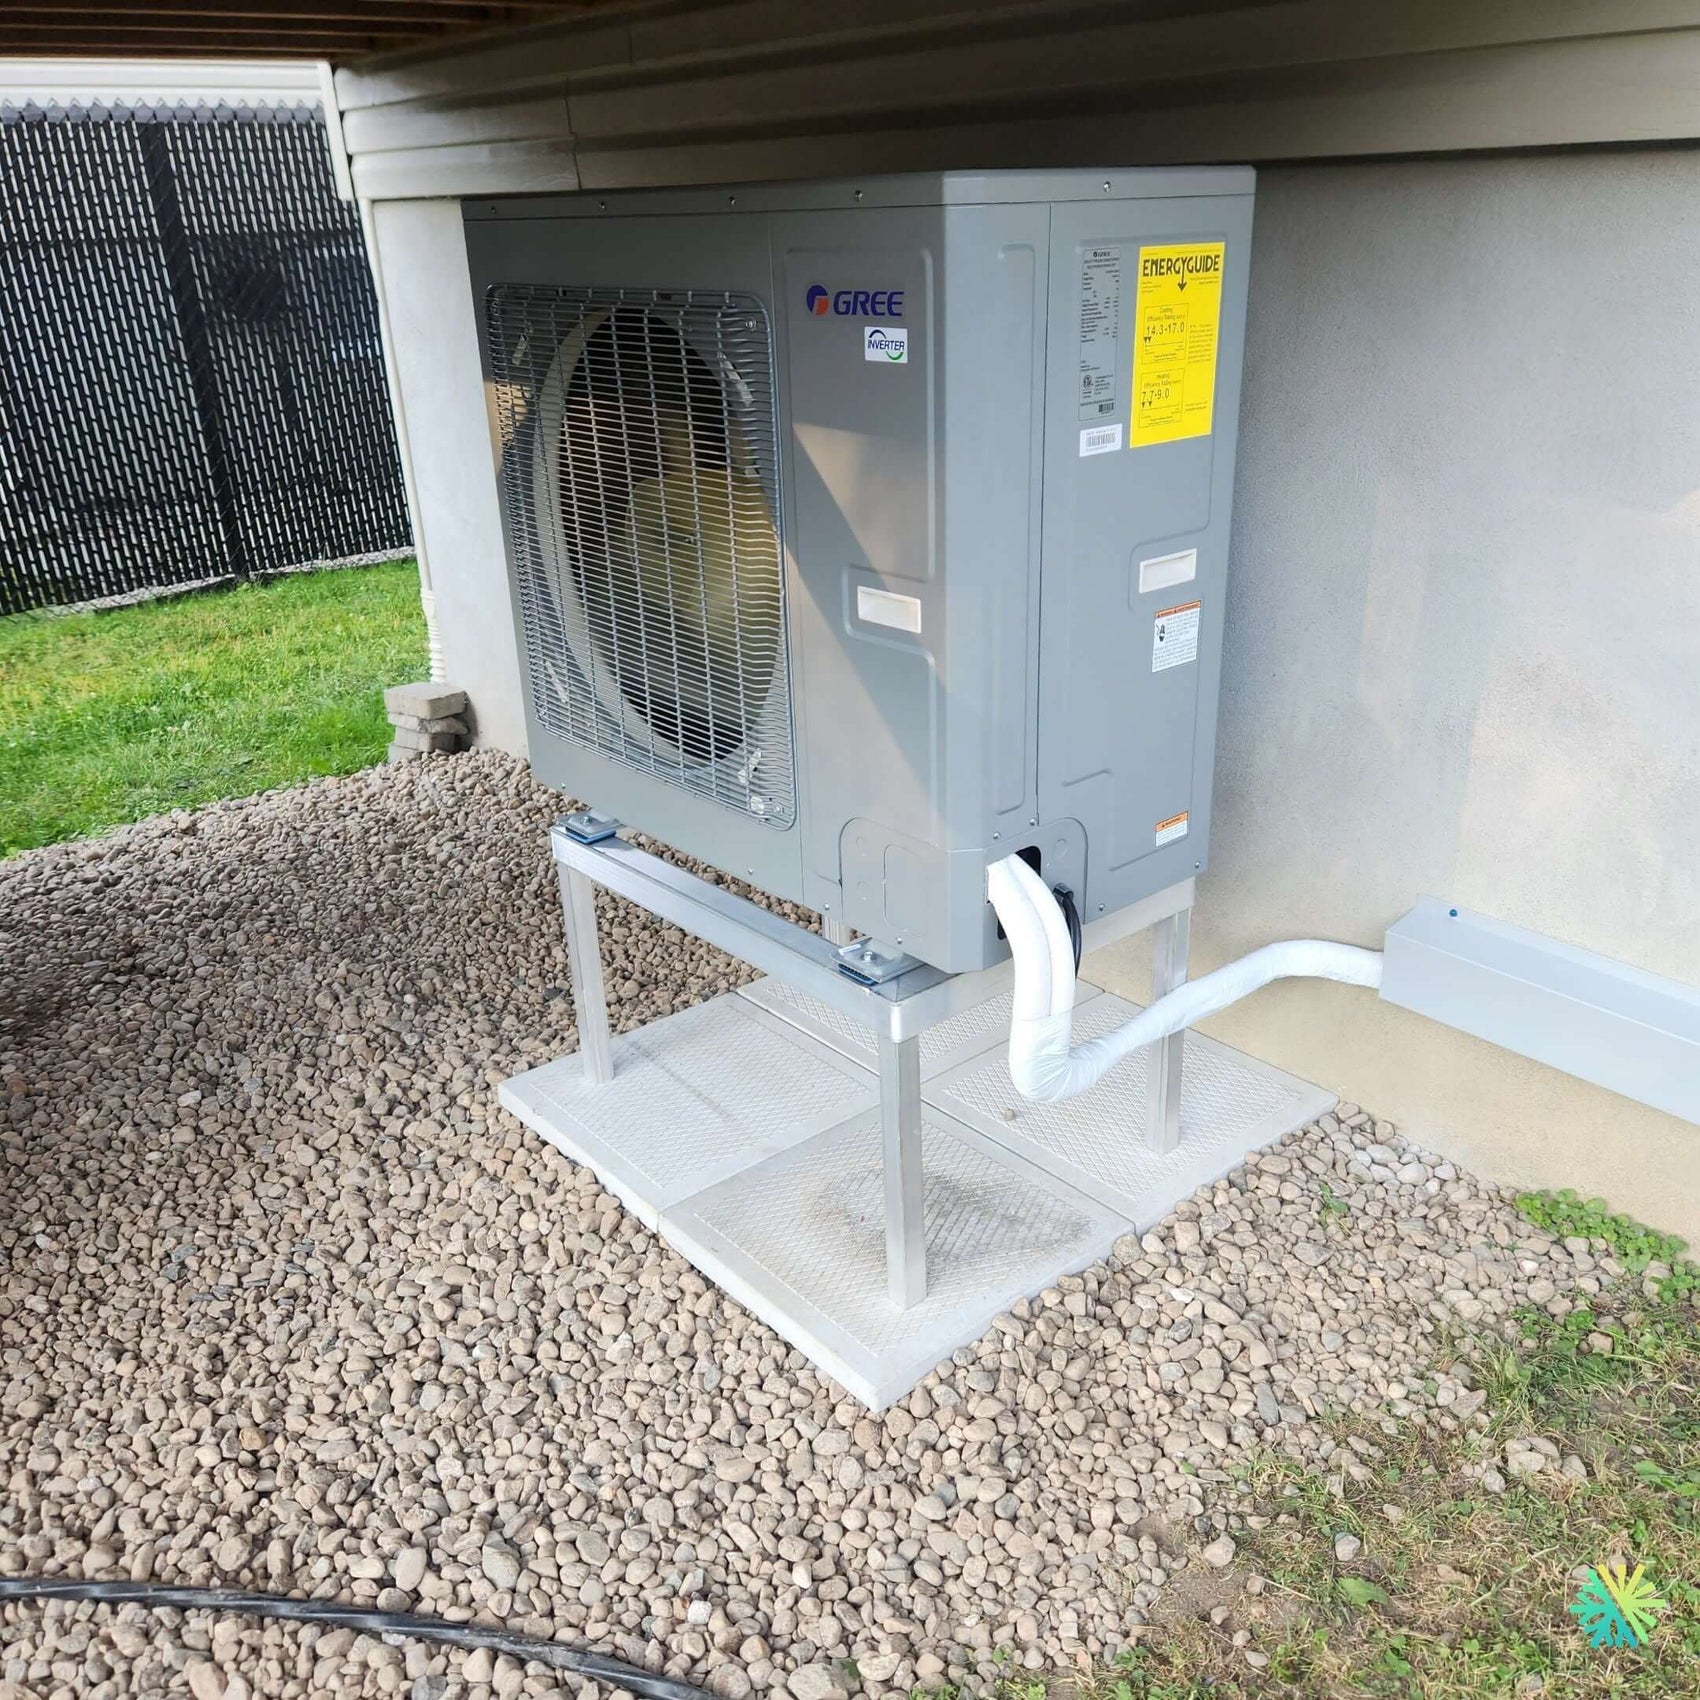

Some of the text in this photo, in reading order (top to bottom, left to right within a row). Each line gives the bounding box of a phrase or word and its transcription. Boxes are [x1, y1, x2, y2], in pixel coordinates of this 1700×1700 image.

[1142, 254, 1220, 278] ENERGYGUIDE
[833, 290, 905, 317] GREE
[1146, 321, 1185, 336] 14.3-17.0
[867, 339, 905, 352] INVERTER
